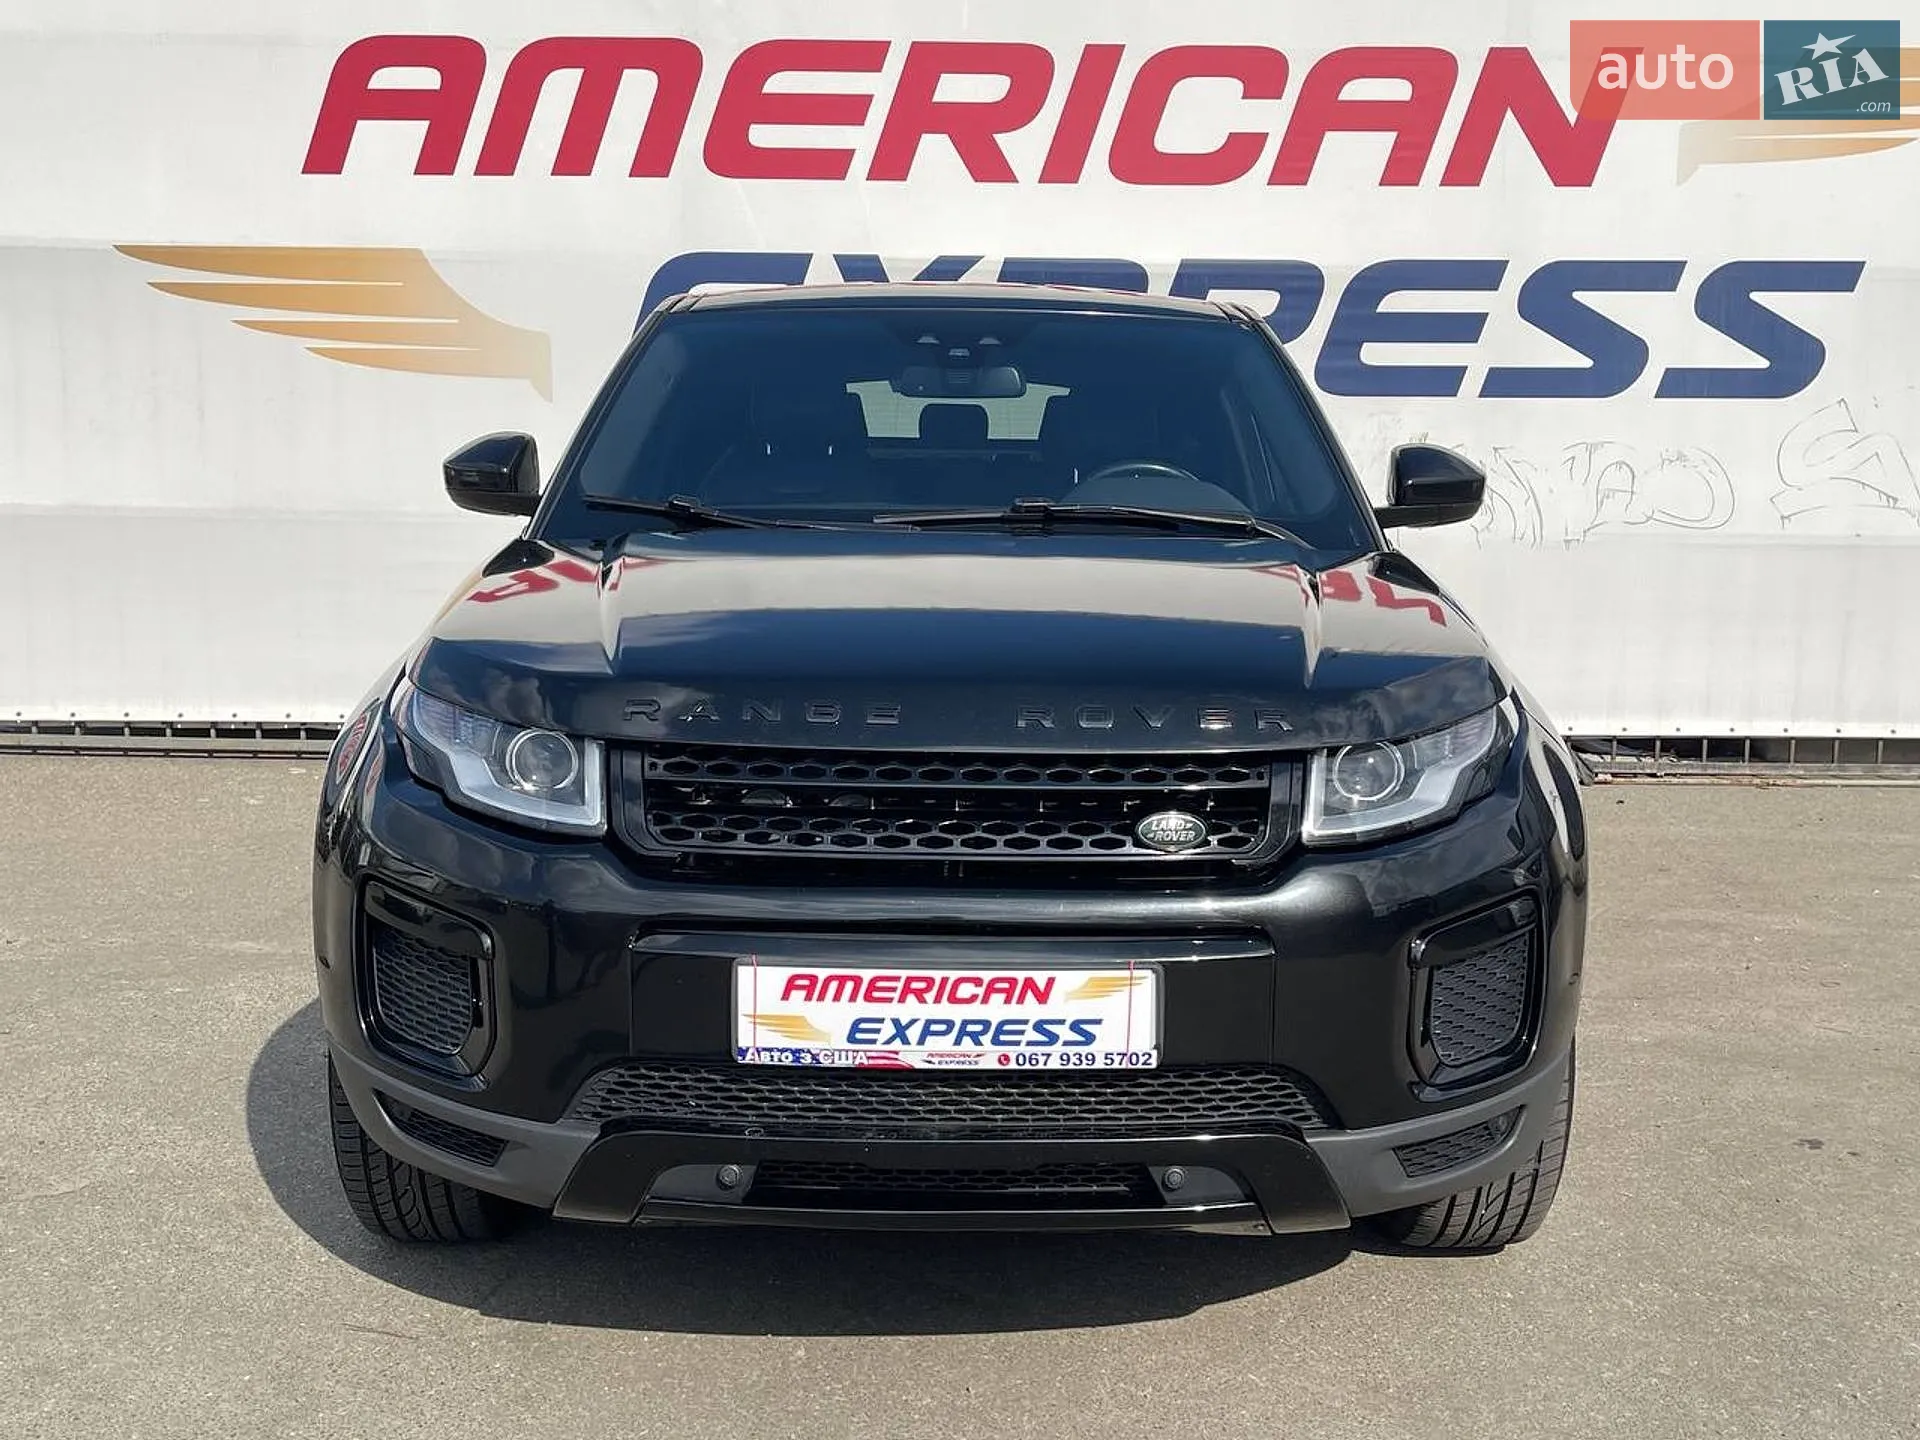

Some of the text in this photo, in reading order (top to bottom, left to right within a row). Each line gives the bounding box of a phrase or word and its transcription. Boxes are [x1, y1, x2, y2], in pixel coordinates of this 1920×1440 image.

[301, 35, 1643, 187] AMERICAN
[624, 697, 1293, 731] RANGE ROVER
[1152, 820, 1185, 830] LAND
[1154, 831, 1195, 841] ROVER
[780, 973, 1056, 1005] AMERICAN
[846, 1017, 1103, 1047] EXPRESS
[745, 1048, 793, 1064] Авто
[818, 1050, 869, 1065] США
[1015, 1052, 1153, 1067] 067 939 5702
